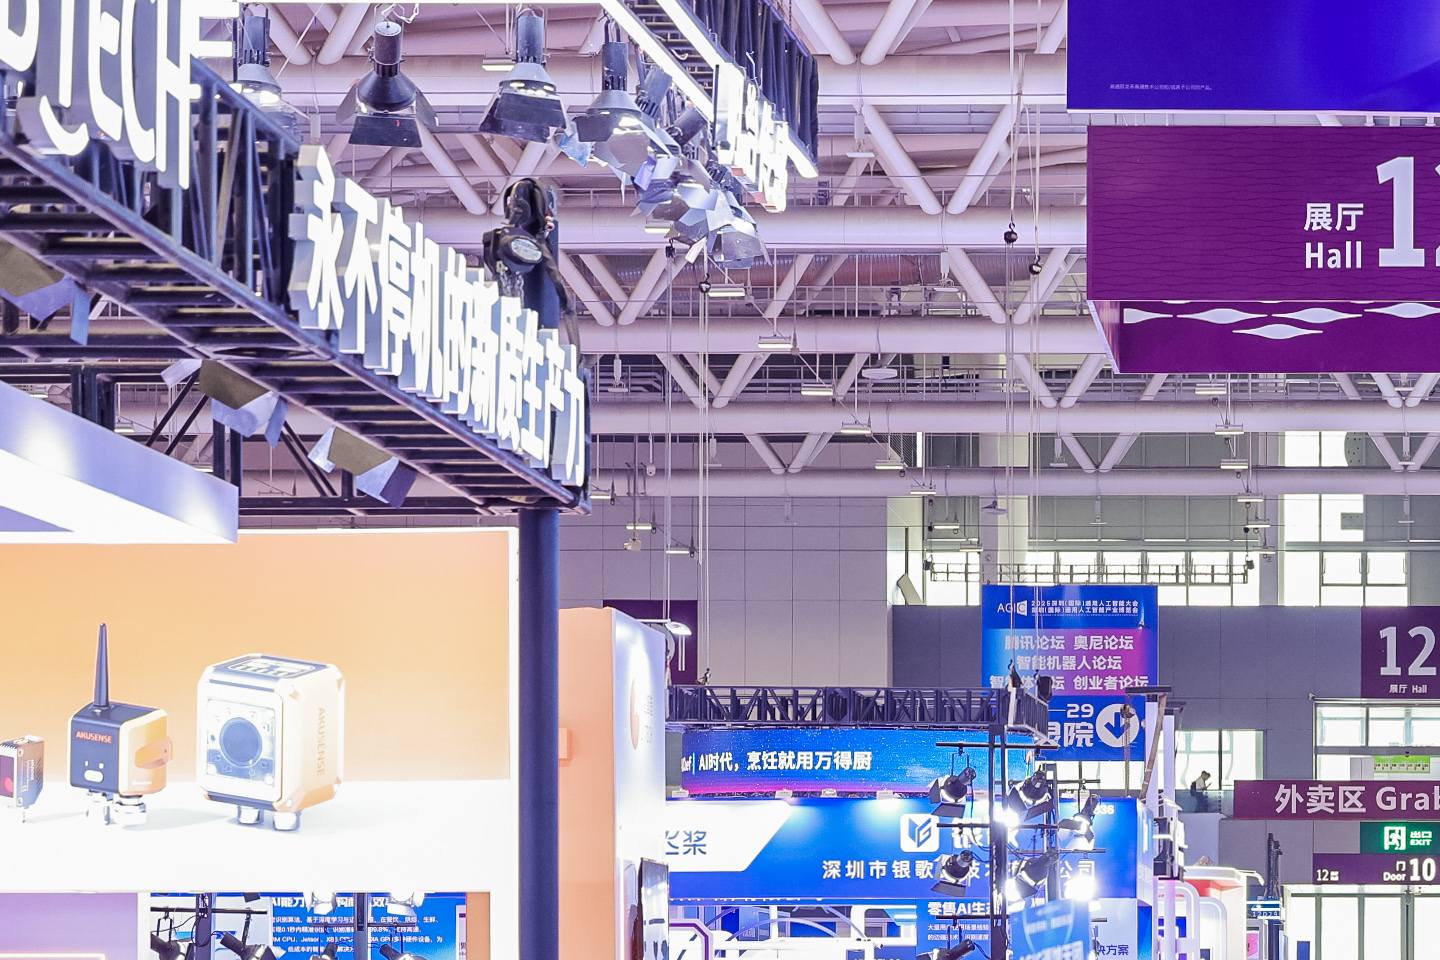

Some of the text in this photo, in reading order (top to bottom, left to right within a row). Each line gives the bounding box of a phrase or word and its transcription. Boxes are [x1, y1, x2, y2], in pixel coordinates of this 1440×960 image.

[1303, 203, 1364, 231] 展厅
[1305, 240, 1362, 269] Hall
[307, 146, 585, 487] 永不停机的新质生产力
[1005, 635, 1134, 650] 腾讯论坛 奥尼论坛
[1379, 626, 1437, 676] 12
[1017, 655, 1122, 671] 智能机器人论坛
[1073, 675, 1149, 690] 创业者论坛
[1388, 684, 1428, 694] 展厅 Hall
[76, 730, 112, 744] AKUSENSE
[1274, 784, 1367, 814] 外卖区
[1410, 838, 1432, 846] EXIT
[1383, 858, 1436, 881] Door 10
[1396, 861, 1406, 872] 门
[1316, 869, 1329, 881] 12
